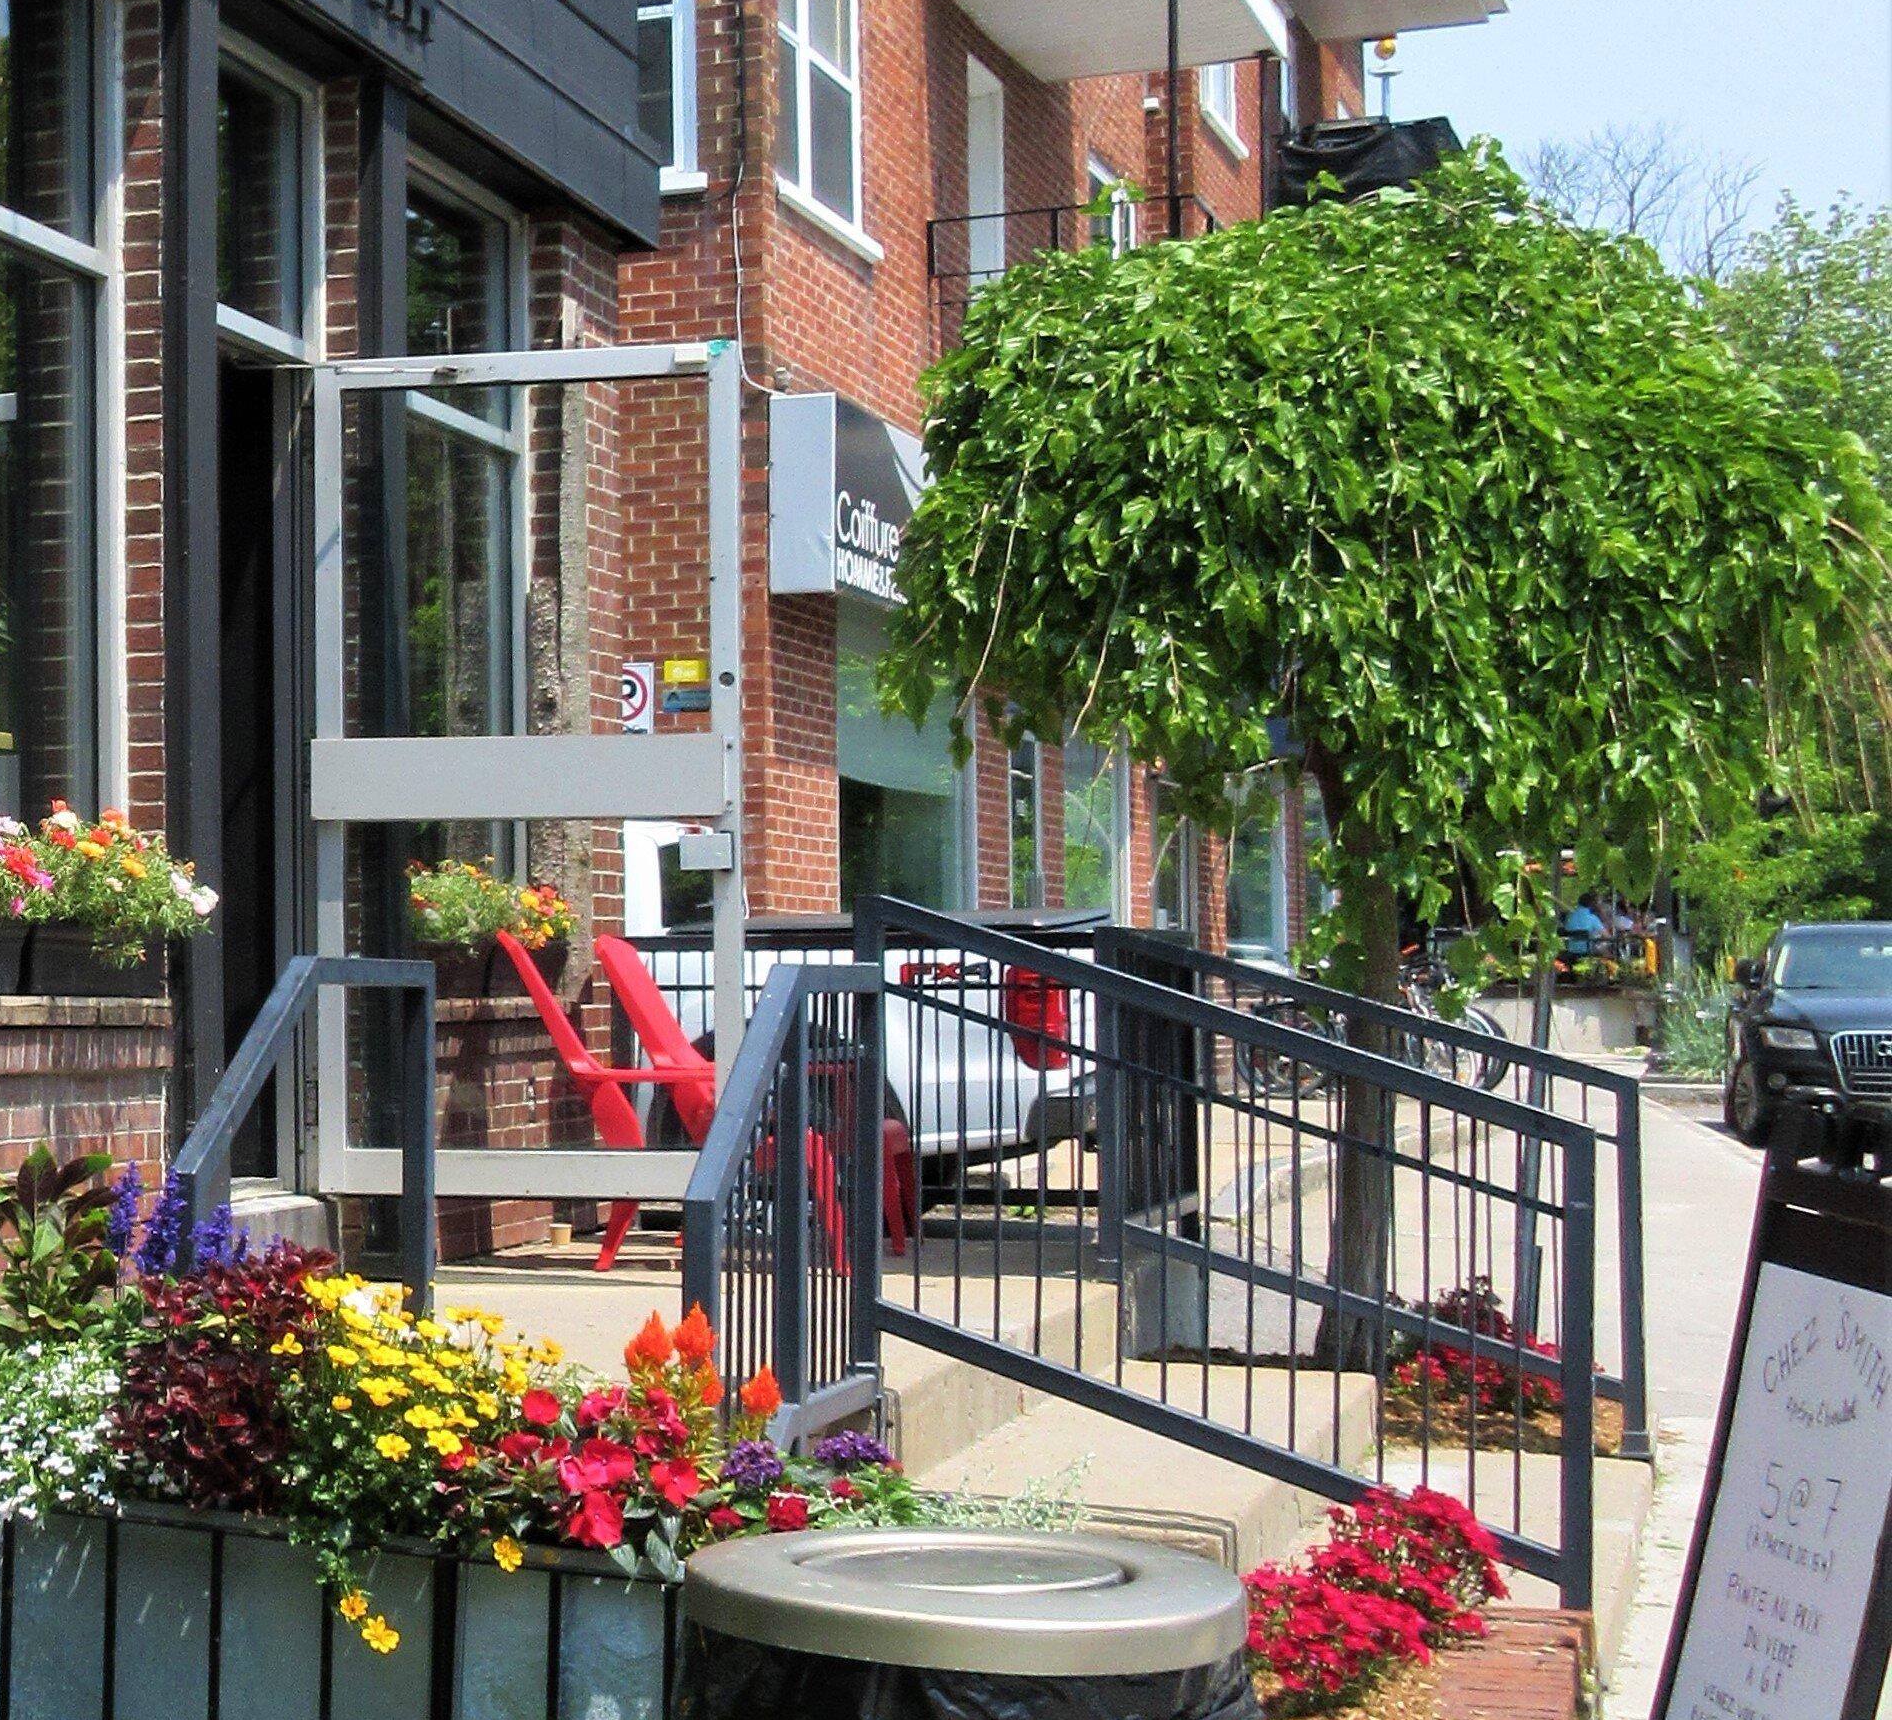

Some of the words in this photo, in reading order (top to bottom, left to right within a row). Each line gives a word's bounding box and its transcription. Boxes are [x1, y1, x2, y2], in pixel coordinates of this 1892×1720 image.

[837, 490, 900, 562] Coiffure
[1763, 1316, 1821, 1394] CHEZ
[1835, 1309, 1892, 1409] SMITH
